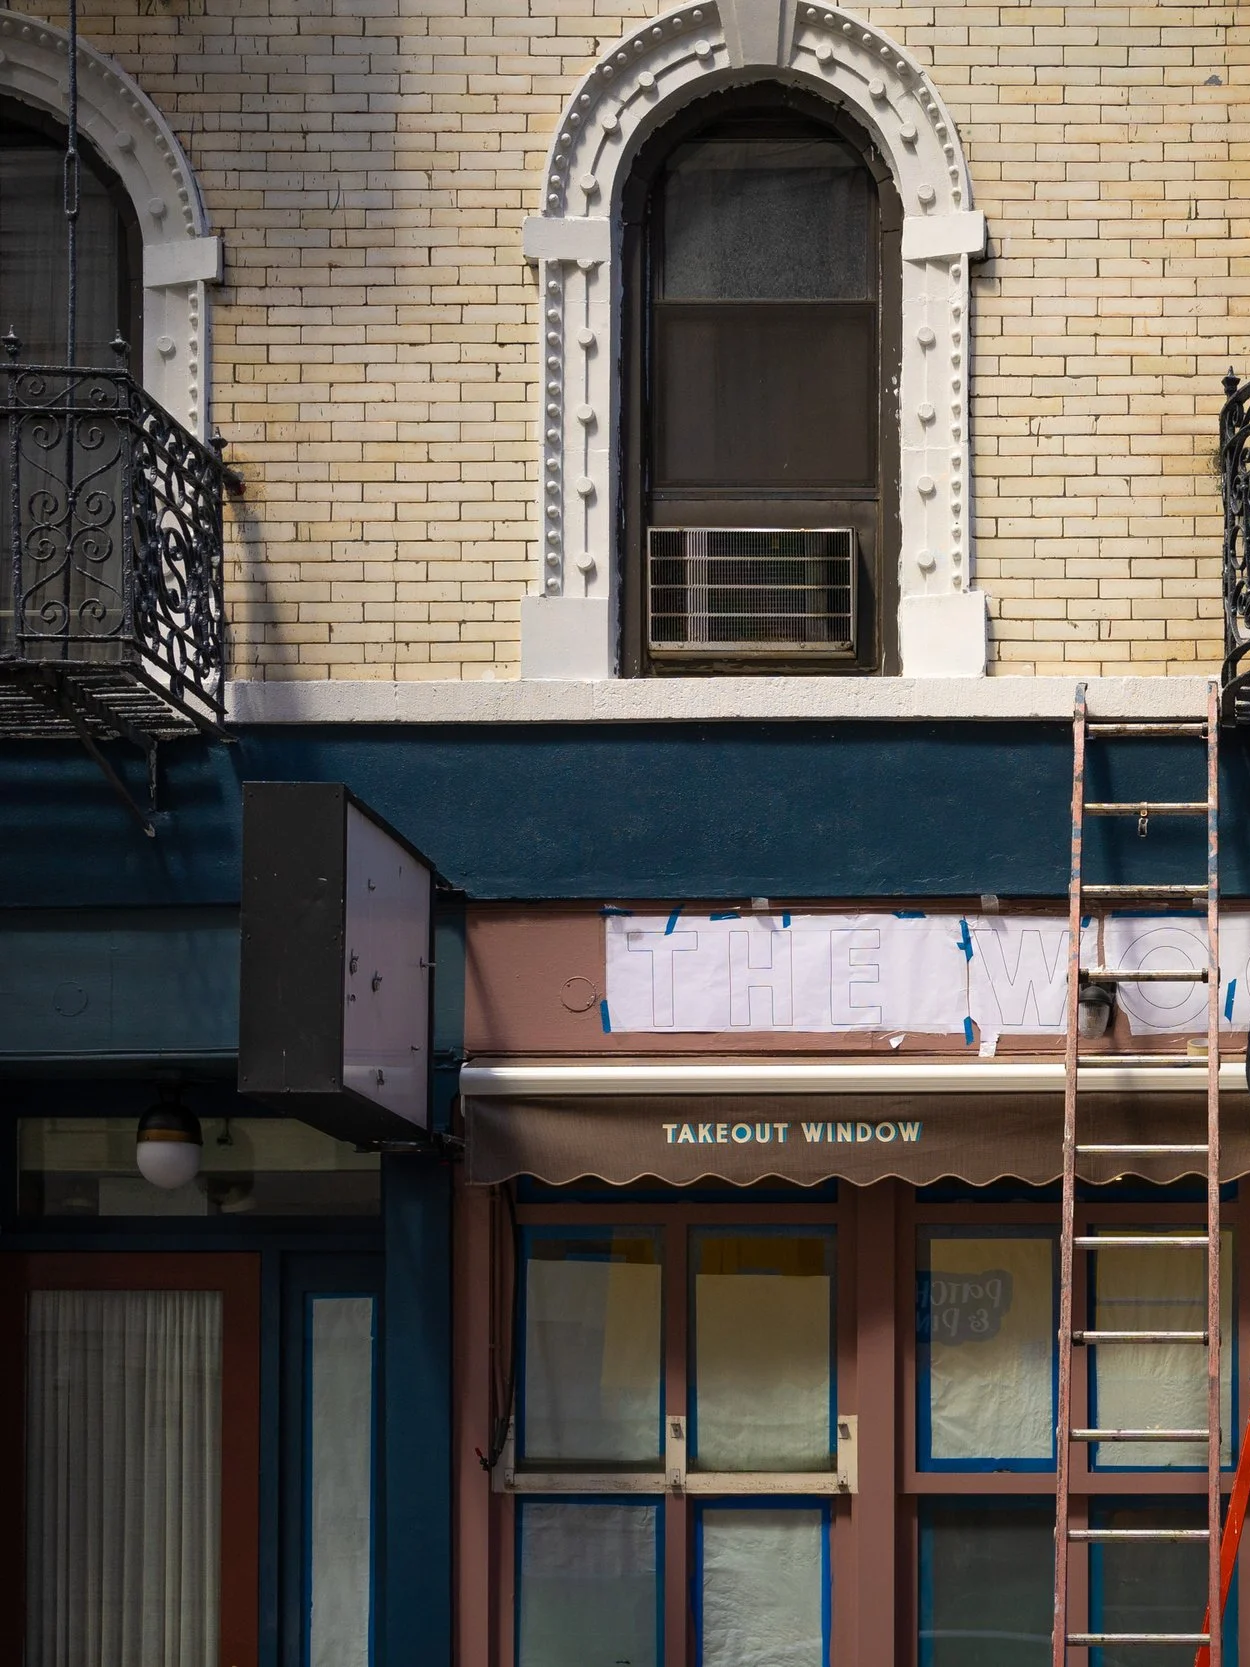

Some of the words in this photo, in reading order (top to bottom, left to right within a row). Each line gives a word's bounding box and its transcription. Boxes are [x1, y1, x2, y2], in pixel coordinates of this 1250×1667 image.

[627, 928, 882, 1027] THE
[662, 1122, 790, 1143] TAKEOUT
[801, 1121, 923, 1143] WINDOW
